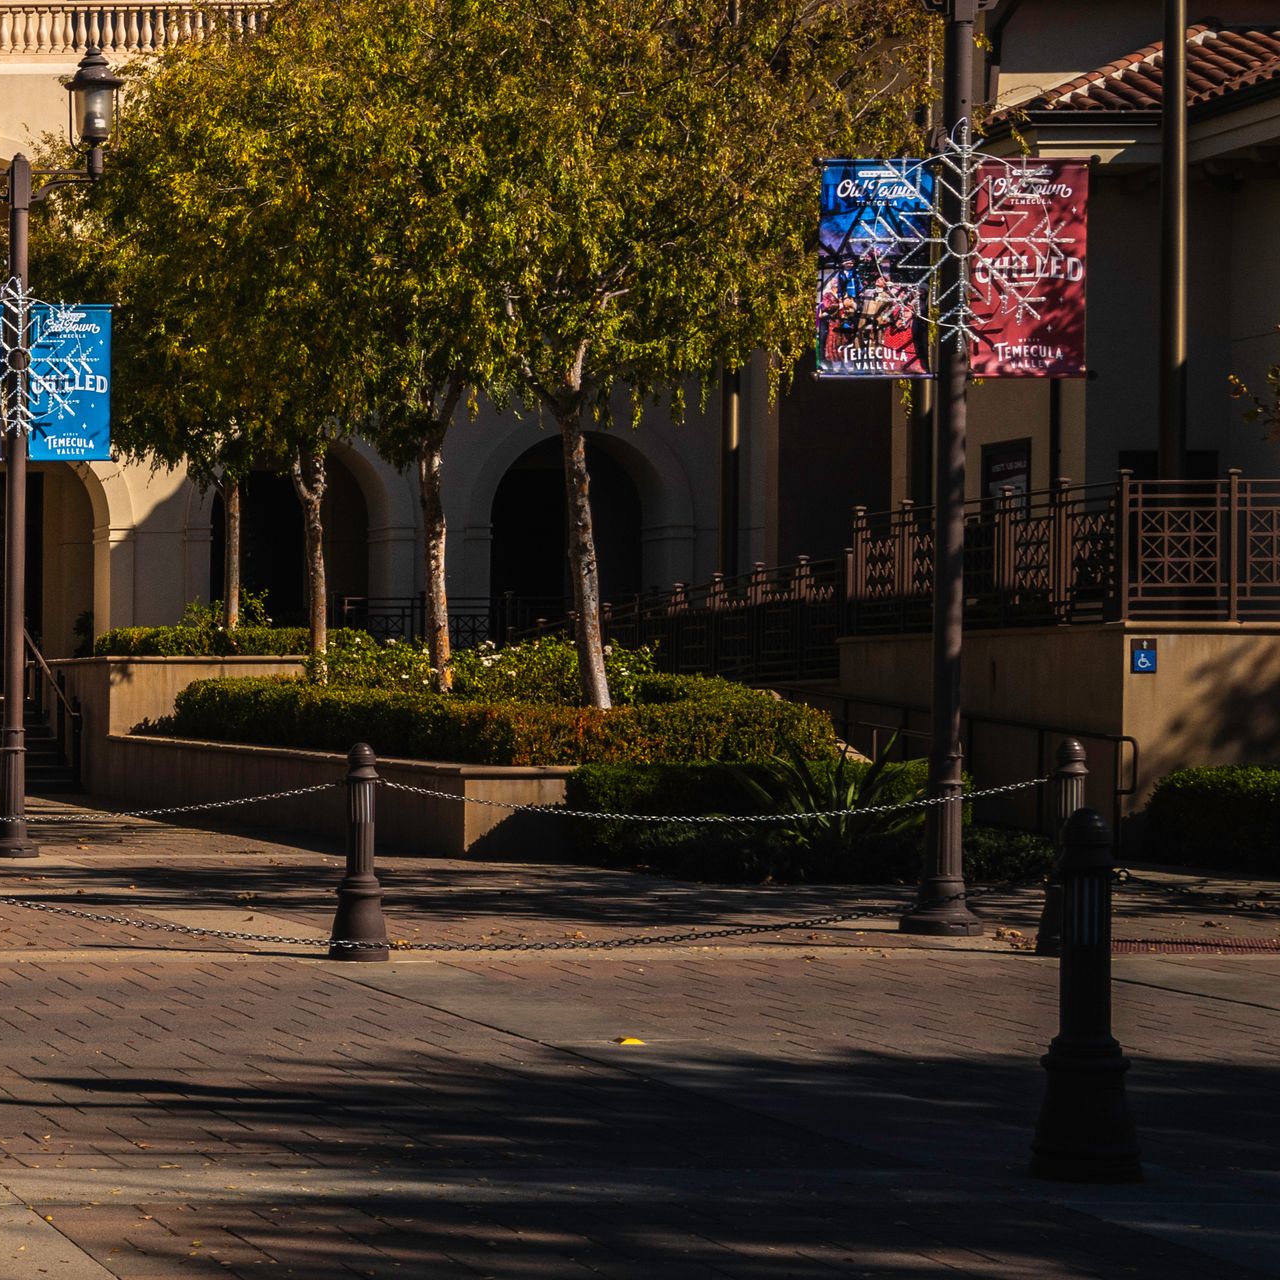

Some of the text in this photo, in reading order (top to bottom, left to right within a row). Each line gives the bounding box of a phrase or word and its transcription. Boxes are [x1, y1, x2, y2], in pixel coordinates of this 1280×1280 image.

[837, 179, 868, 198] Old
[975, 255, 1083, 284] CHILLED
[63, 318, 101, 334] Town
[837, 343, 908, 363] TEMECULA
[992, 341, 1064, 362] TEMECULA
[855, 361, 895, 370] VALLEY
[1010, 359, 1052, 369] VALLEY
[43, 434, 95, 450] TEMECULA
[56, 448, 85, 456] VALLEY
